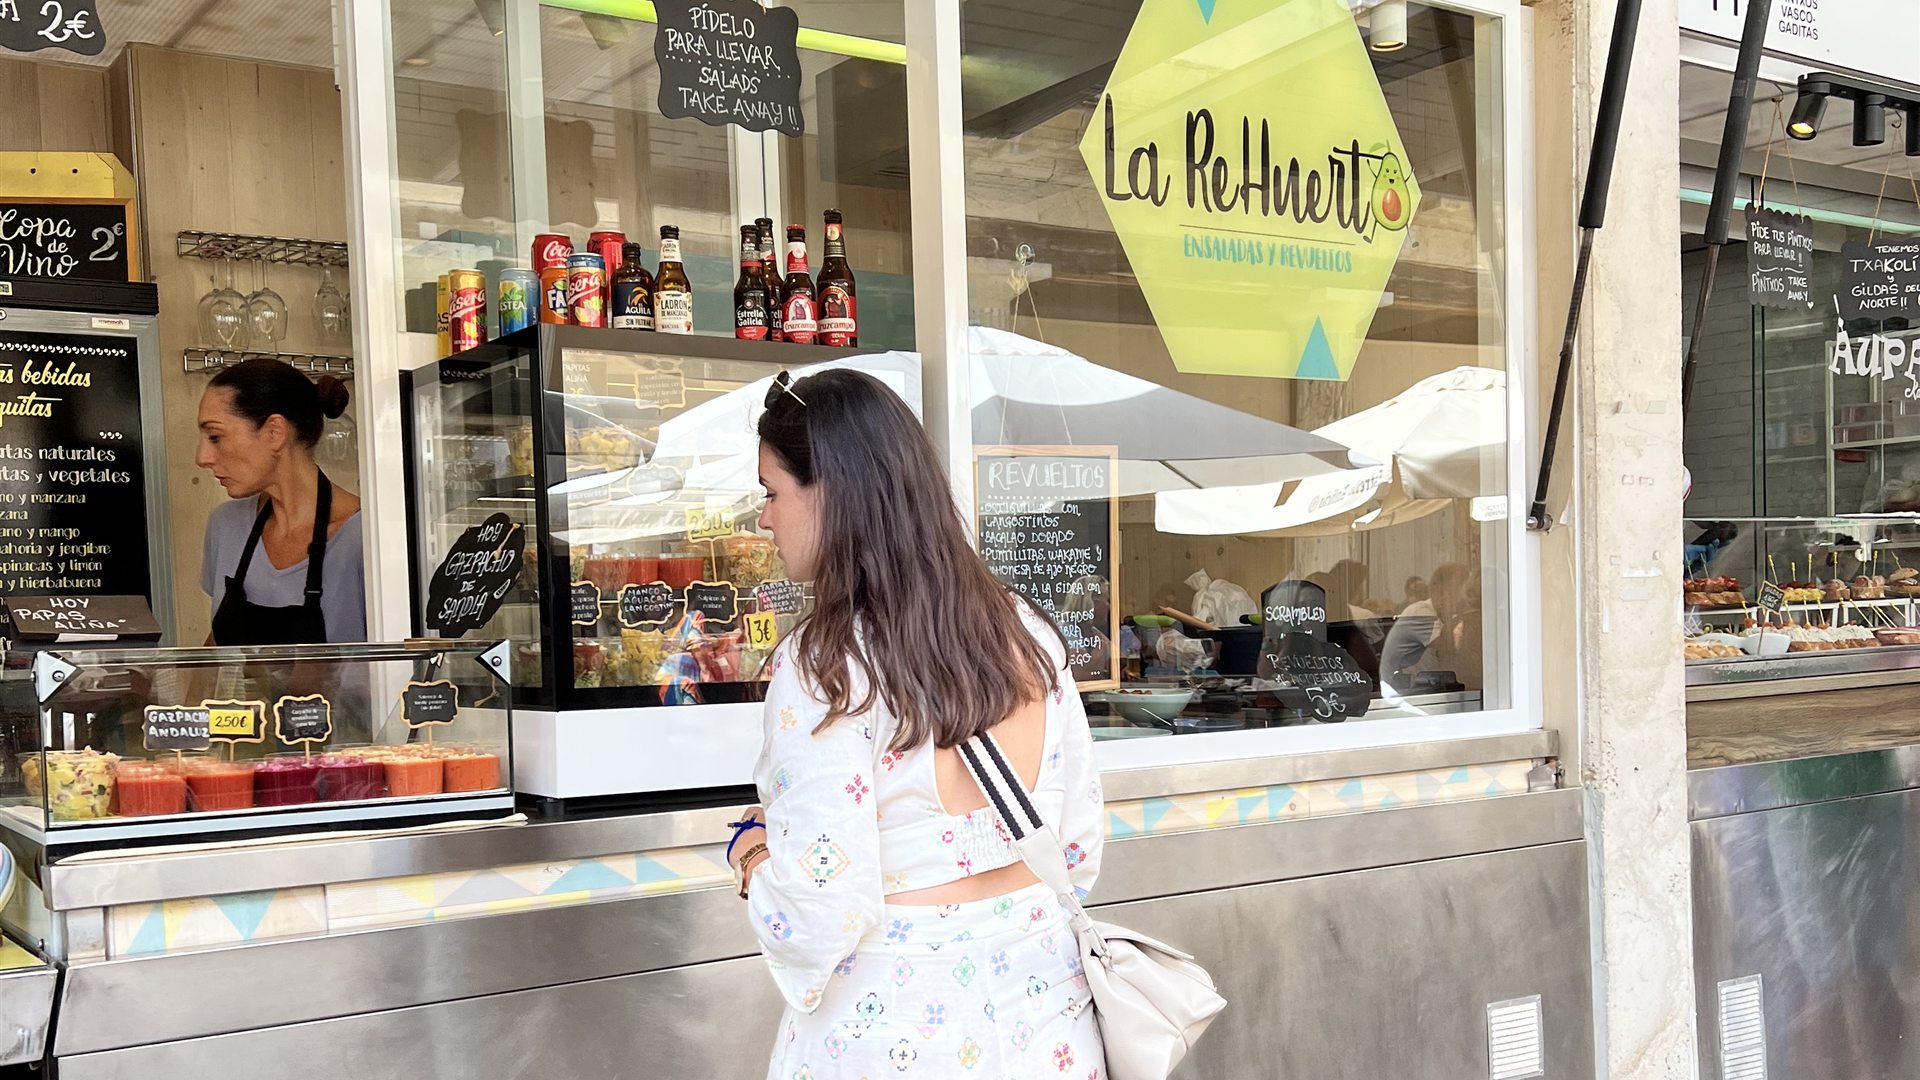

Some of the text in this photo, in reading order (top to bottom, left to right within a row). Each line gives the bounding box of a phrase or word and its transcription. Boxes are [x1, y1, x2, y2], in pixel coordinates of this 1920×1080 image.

[689, 3, 755, 39] PÍDELO
[1781, 5, 1816, 23] VASCO-
[1779, 20, 1819, 40] GADITAS
[665, 28, 781, 71] PARA LLEVAR
[699, 66, 761, 94] SALADS
[678, 86, 729, 114] TAKE
[733, 98, 783, 126] AWAY
[1104, 92, 1171, 208] La
[0, 208, 77, 247] Copa
[1751, 220, 1813, 252] PIDE TUS PINTXOS
[47, 238, 69, 254] de
[1184, 233, 1352, 273] ENSALADAS Y REVUELTOS
[1753, 241, 1772, 256] PARA
[1874, 245, 1920, 254] TENEMOS
[0, 242, 79, 277] Vino
[1849, 254, 1919, 273] TXAKOLÍ
[1752, 271, 1808, 293] PINTXOS TAKE
[1787, 290, 1808, 302] AWAY
[1859, 296, 1899, 310] NORTE
[737, 308, 764, 319] Estrella
[738, 319, 763, 328] Galicia
[21, 359, 92, 388] bebidas
[38, 445, 116, 462] naturales
[35, 472, 43, 484] y
[48, 468, 131, 486] vegetales
[988, 461, 1105, 490] REVUELTOS
[18, 493, 27, 506] y
[31, 493, 86, 504] manzana
[26, 527, 35, 540] y
[39, 527, 81, 541] mango
[477, 522, 503, 543] HOY
[984, 529, 1076, 548] BACALAO DORADO
[46, 545, 55, 557] y
[58, 542, 112, 558] jengibre
[57, 561, 66, 575] y
[69, 557, 103, 572] limón
[445, 549, 516, 581] GAZPACHO
[20, 576, 102, 589] hierbabuena
[459, 579, 477, 594] DE
[1031, 582, 1039, 597] A
[1041, 582, 1053, 598] LA
[1055, 580, 1085, 596] SIDRA
[624, 593, 673, 604] AGUACATE
[627, 588, 660, 596] MANGO
[49, 597, 89, 609] HOY
[13, 608, 86, 621] PAPAS
[1050, 607, 1095, 623] NFITADOS
[1265, 604, 1326, 626] SCRAMBLED
[753, 619, 773, 643] 3€
[1266, 653, 1344, 671] REVUELTOS
[1343, 671, 1367, 684] POR
[1305, 687, 1346, 718] 5€
[148, 726, 211, 738] ANDALUZ
